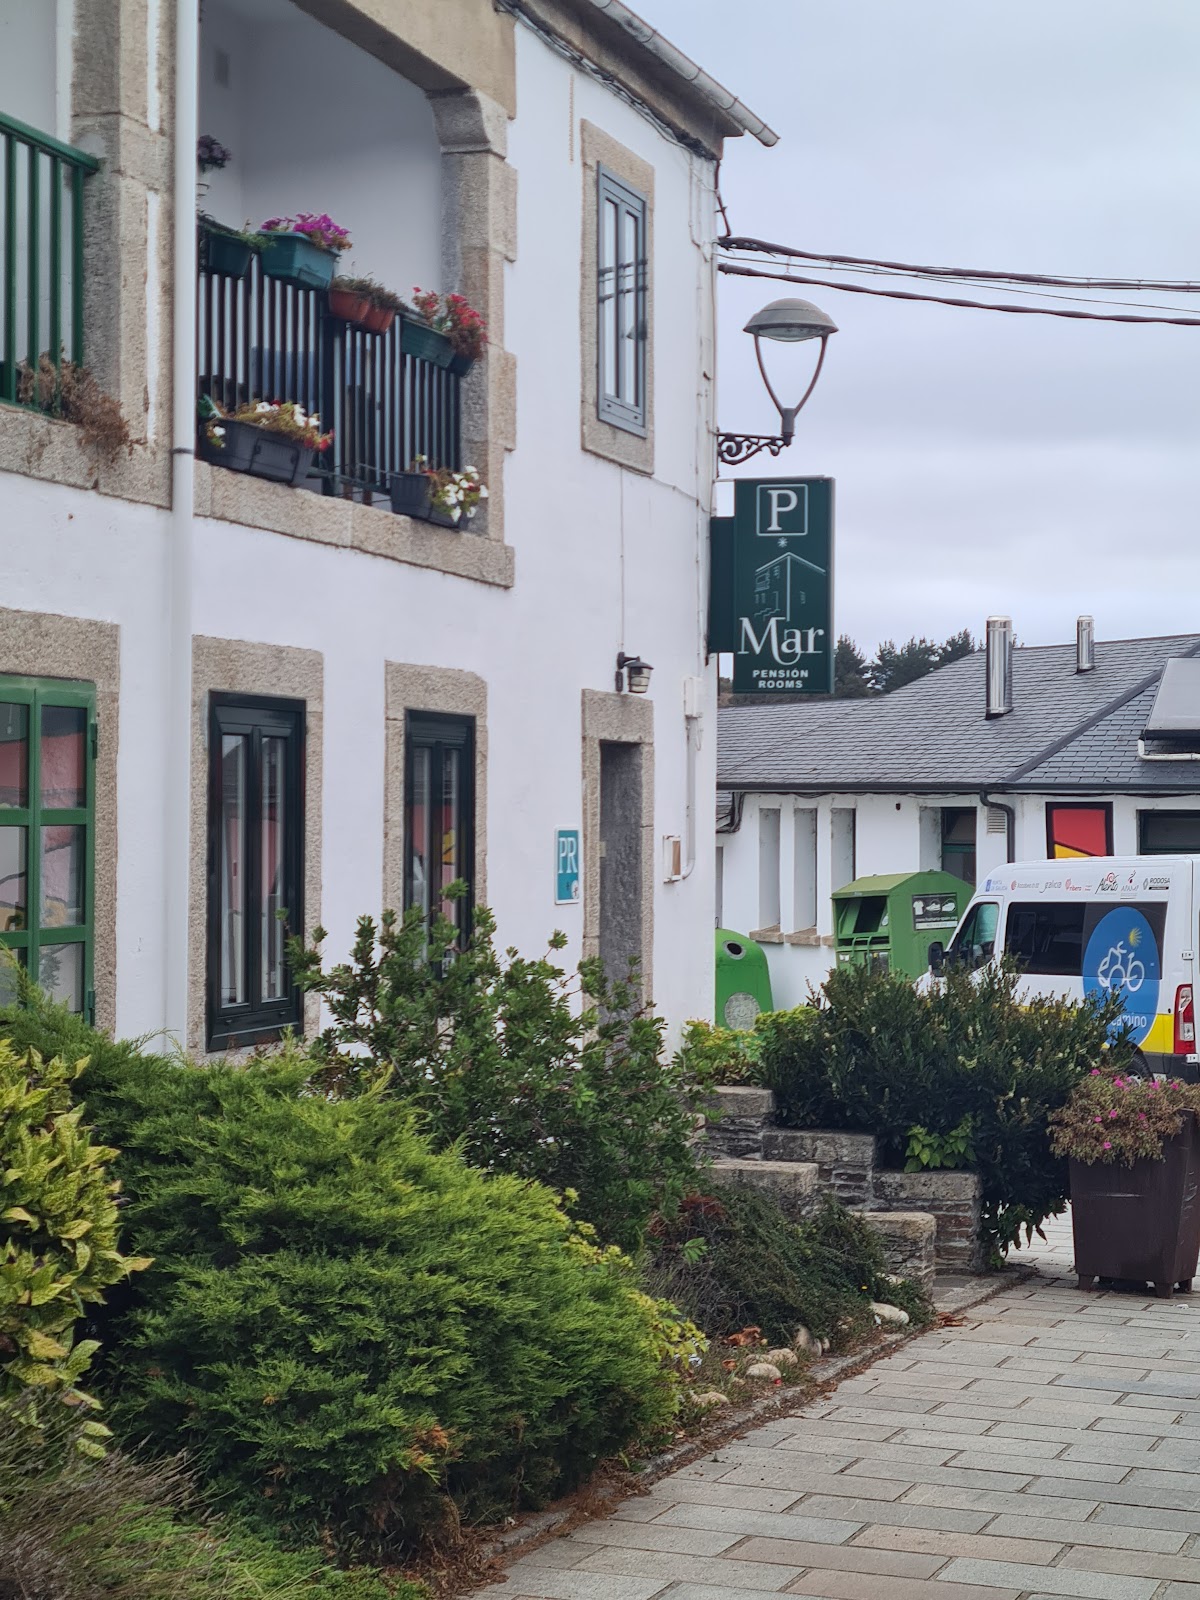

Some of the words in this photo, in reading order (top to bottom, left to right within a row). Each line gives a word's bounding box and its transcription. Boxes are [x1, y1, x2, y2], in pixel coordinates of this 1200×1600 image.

[767, 489, 798, 531] P
[737, 616, 825, 666] Mar
[752, 668, 809, 678] PENSIÓN
[758, 680, 803, 689] ROOMS
[558, 837, 578, 873] PR
